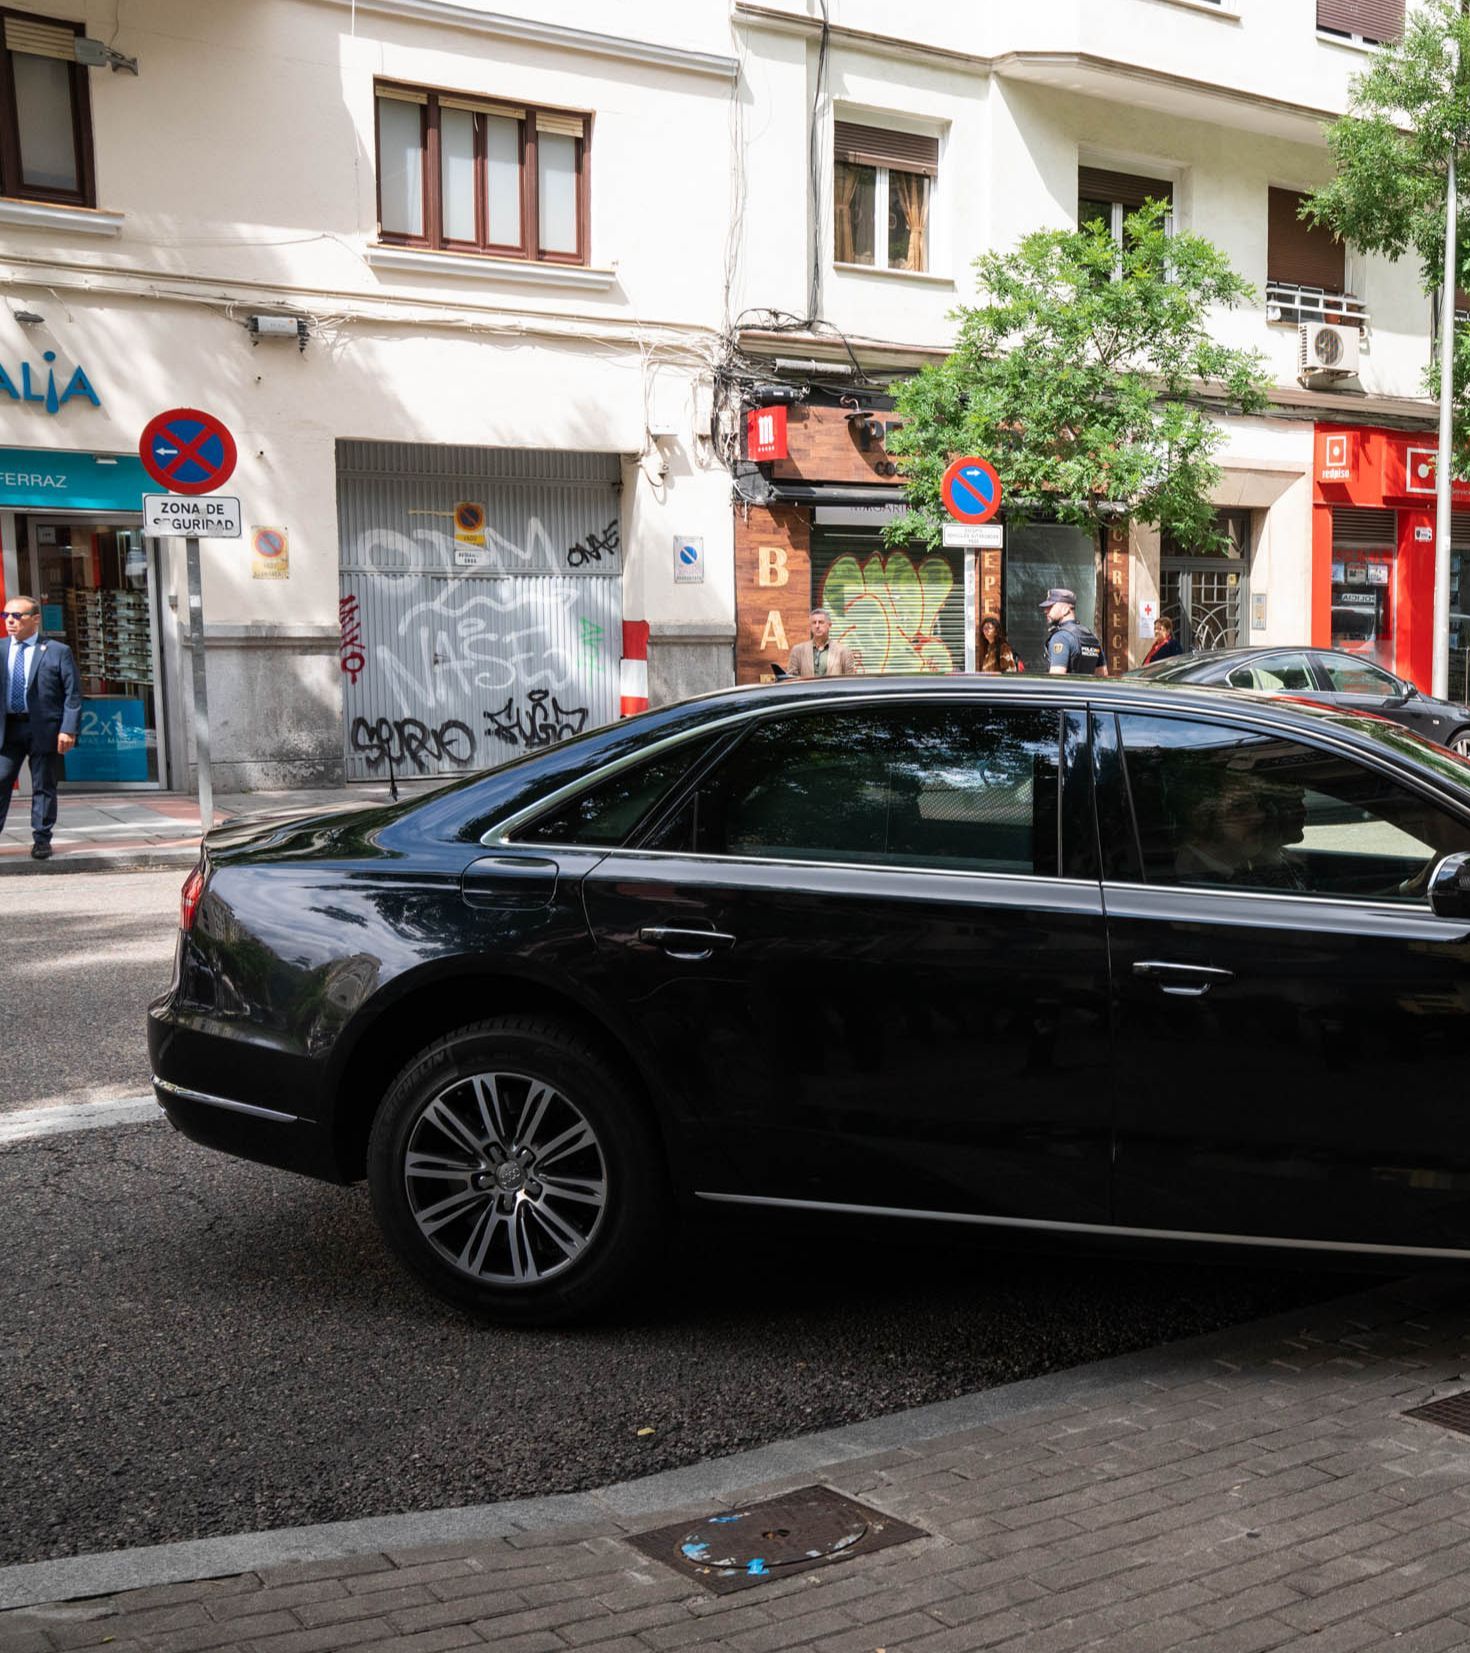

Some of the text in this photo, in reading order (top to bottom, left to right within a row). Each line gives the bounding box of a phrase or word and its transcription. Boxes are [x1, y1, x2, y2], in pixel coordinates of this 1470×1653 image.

[1321, 469, 1350, 479] redpiso
[161, 502, 225, 516] ZONA DE
[153, 517, 234, 532] SGURIDAD
[759, 547, 790, 684] BA
